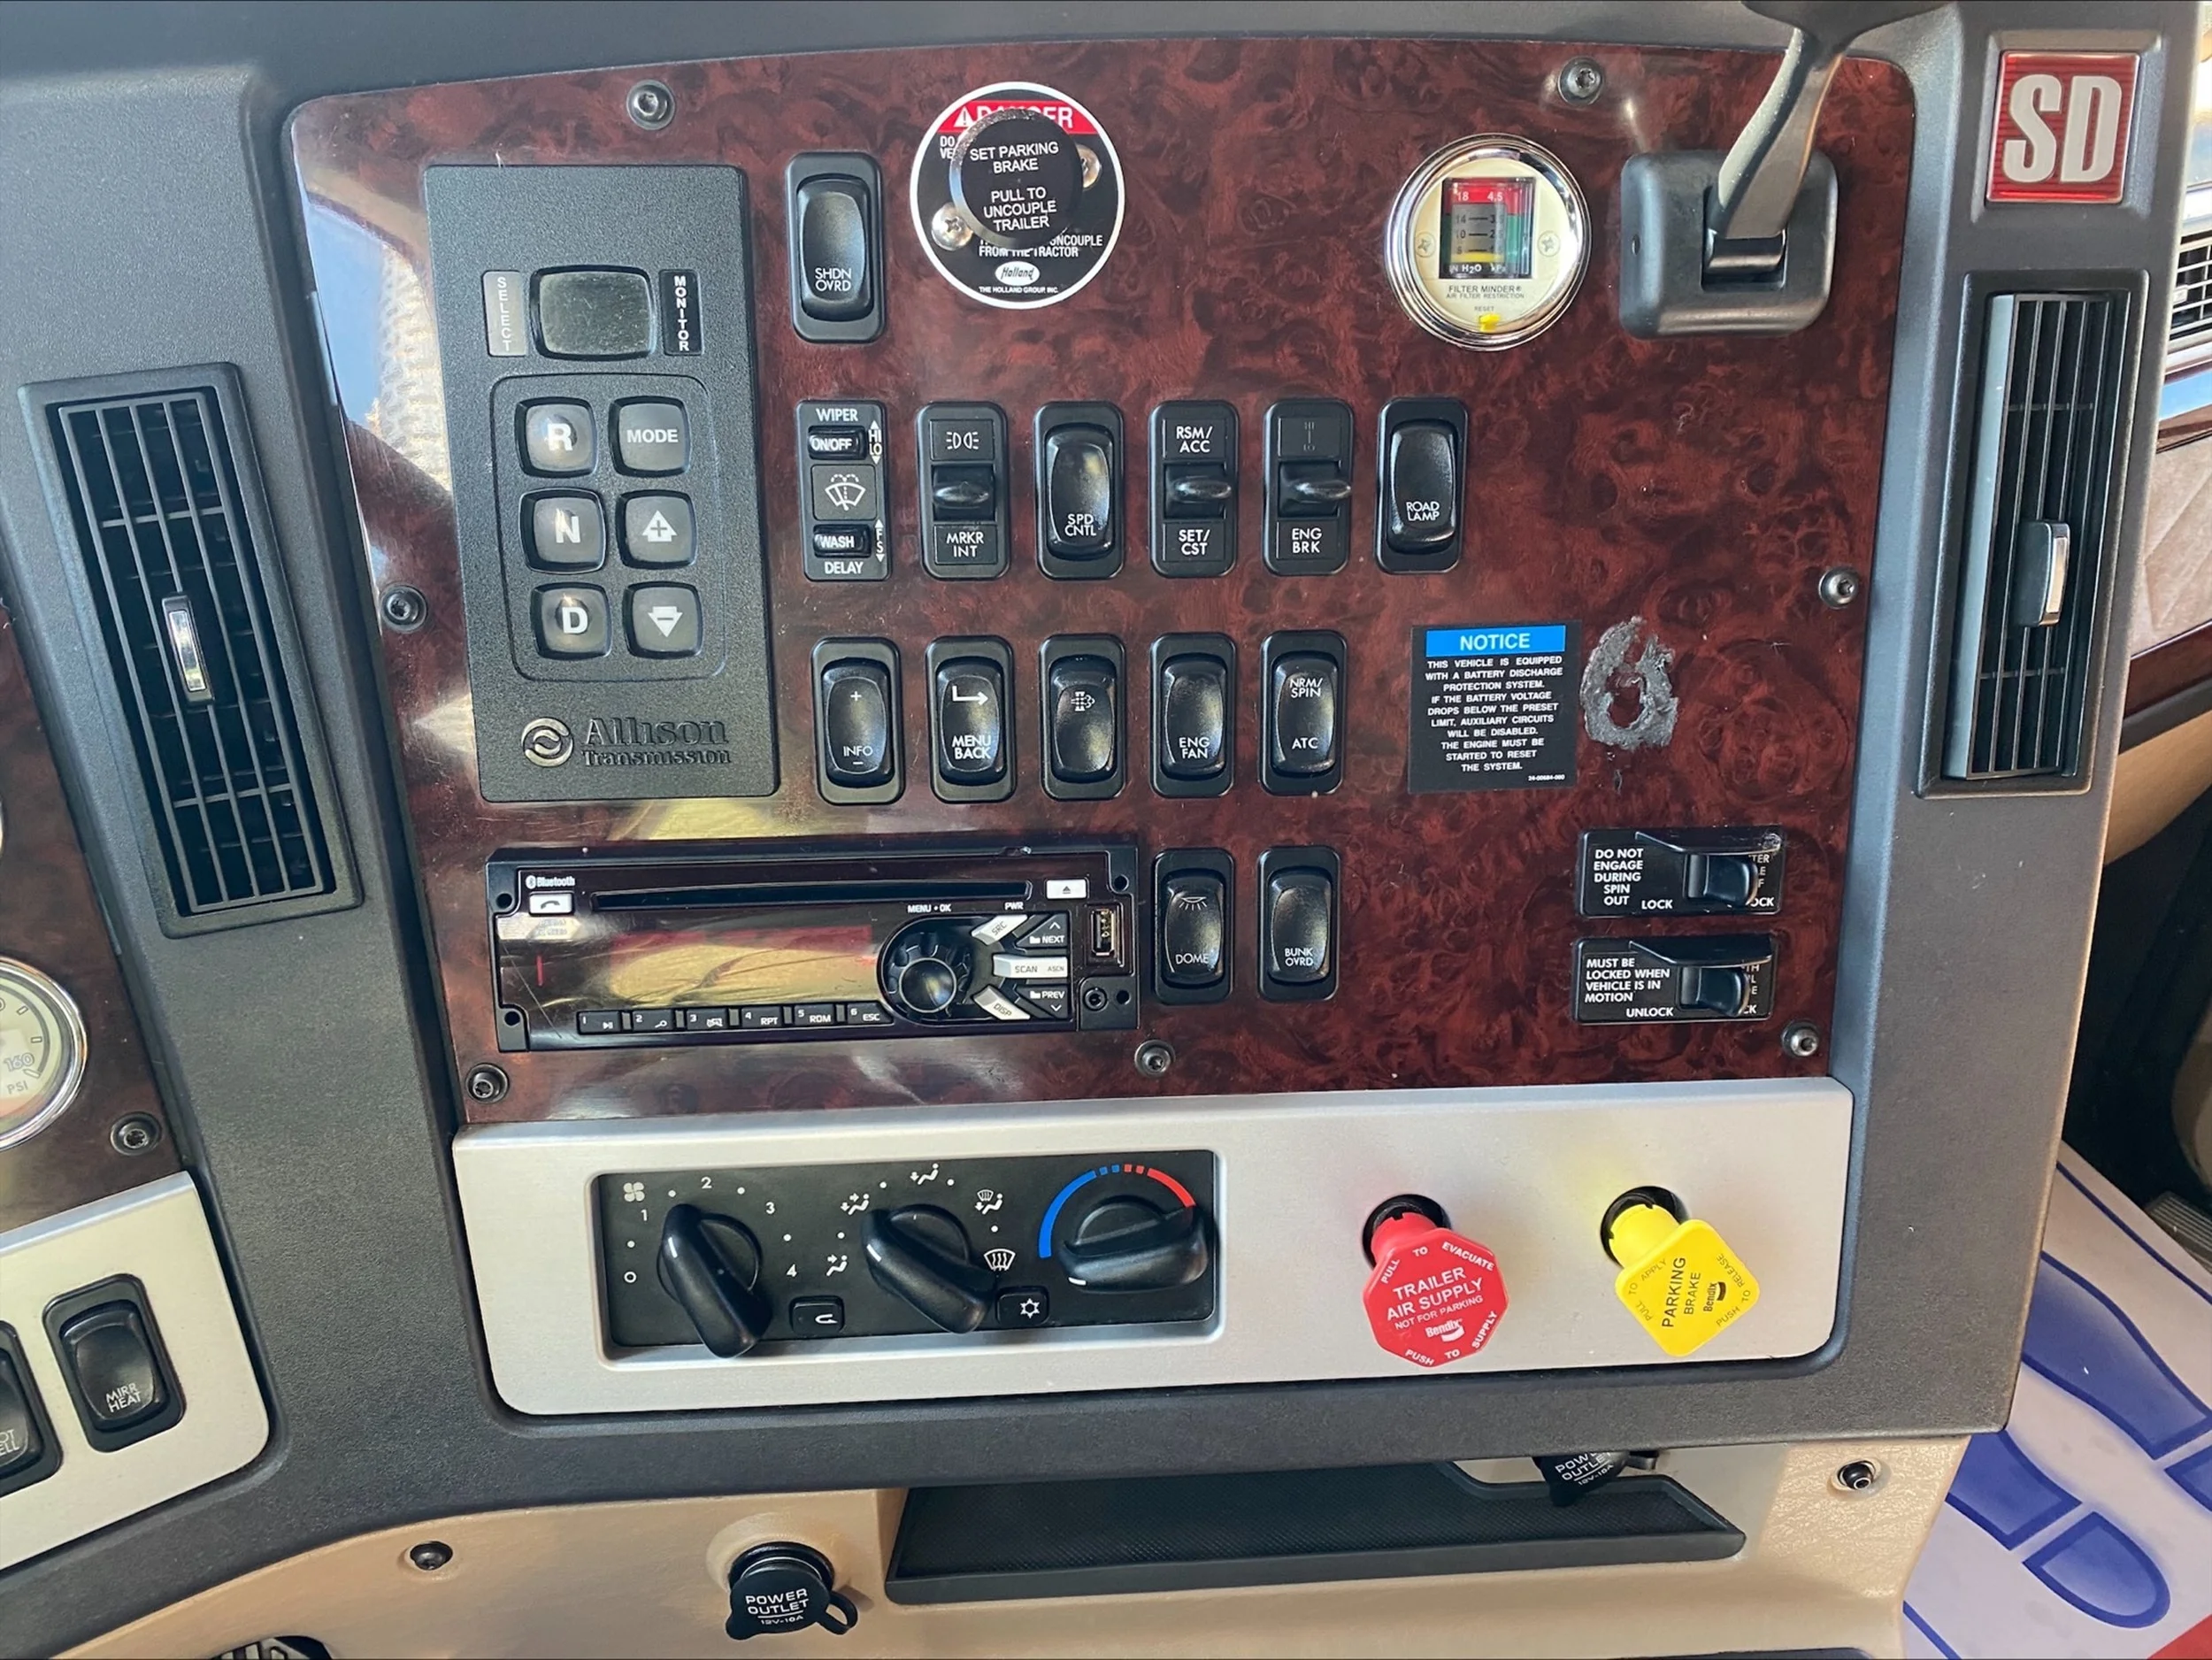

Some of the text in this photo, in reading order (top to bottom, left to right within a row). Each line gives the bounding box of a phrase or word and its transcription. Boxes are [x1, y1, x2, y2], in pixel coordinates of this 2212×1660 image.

[2002, 74, 2122, 183] SD
[941, 136, 955, 147] DO
[970, 147, 995, 161] SET
[999, 142, 1059, 158] PARKING
[994, 158, 1039, 173] BRAKE
[991, 187, 1046, 203] PULL TO
[1458, 191, 1502, 202] 18 4.5
[984, 200, 1056, 219] UNCOUPLE
[994, 216, 1049, 232] TRAILER
[979, 246, 1008, 257] FROM
[815, 267, 851, 280] SHDN
[1001, 267, 1034, 280] Holland
[815, 280, 851, 291] OVRD
[497, 277, 511, 350] SELECT
[674, 276, 689, 351] MONITOR
[816, 409, 858, 422] WIPER
[547, 423, 573, 451] R
[626, 429, 679, 442] MODE
[868, 429, 881, 442] HI
[1176, 426, 1212, 440] RSM/
[810, 437, 852, 450] ON/OFF
[869, 442, 882, 455] LO
[1179, 441, 1210, 453] ACC
[1406, 502, 1440, 511] ROAD
[1067, 514, 1094, 526] SPD
[1407, 511, 1440, 521] LAMP
[556, 513, 580, 543] N
[1065, 525, 1096, 536] CNTL
[1292, 527, 1322, 540] ENG
[819, 535, 855, 548] WASH
[946, 532, 984, 544] MRKR
[1179, 529, 1210, 542] SET/
[877, 542, 884, 554] S
[953, 545, 977, 557] INT
[1180, 542, 1208, 555] CST
[1292, 541, 1320, 554] BRK
[825, 562, 864, 574] DELAY
[562, 607, 588, 634] D
[1460, 633, 1530, 650] NOTICE
[1455, 658, 1494, 668] VEHICLE
[1517, 656, 1562, 665] EQUIPPED
[1464, 670, 1505, 679] BATTERY
[1509, 667, 1563, 677] DISCHARGE
[1290, 678, 1323, 688] NRM/
[1443, 680, 1545, 692] PROTECTION SYSTEM.
[1291, 688, 1321, 698] SPIN
[1466, 694, 1507, 703] BATTERY
[1511, 691, 1552, 701] VOLTAGE
[1428, 707, 1459, 716] DROPS
[1463, 705, 1497, 714] BELOW
[1523, 703, 1559, 711] PRESET
[1461, 717, 1508, 726] AUXILIARY
[585, 717, 729, 745] Allison
[1491, 726, 1538, 736] DISABLED.
[952, 735, 991, 747] MENU
[1179, 737, 1210, 748] ENG
[1292, 738, 1318, 749] ATC
[1463, 740, 1497, 749] ENGINE
[581, 749, 731, 766] Transmission
[843, 746, 872, 757] INFO
[955, 748, 991, 759] BACK
[1182, 748, 1208, 759] FAN
[1446, 752, 1487, 761] STARTED
[1507, 749, 1537, 758] RESET
[1484, 762, 1523, 771] SYSTEM.
[1595, 849, 1644, 859] DO NOT
[1594, 860, 1643, 871] ENGAGE
[1594, 872, 1641, 883] DURING
[1603, 884, 1630, 894] SPIN
[1603, 895, 1630, 905] OUT
[1641, 900, 1672, 910] LOCK
[908, 903, 951, 913] MENU OK
[991, 921, 1007, 935] SRC
[1175, 953, 1209, 964] DOME
[1285, 948, 1313, 957] BUNK
[1285, 957, 1314, 966] OVRD
[1586, 958, 1635, 968] MUST BE
[1586, 968, 1670, 980] LOCKED WHEN
[1586, 980, 1661, 991] VEHICLE IS IN
[1585, 993, 1633, 1003] MOTION
[993, 1003, 1012, 1016] DISP
[1625, 1007, 1674, 1018] UNLOCK
[6, 1053, 35, 1072] 160
[7, 1080, 28, 1095] PSI
[701, 1177, 712, 1189] 2
[765, 1203, 775, 1214] 3
[641, 1209, 648, 1221] 1
[1381, 1241, 1494, 1284] PULL TO EVACUATE
[786, 1264, 797, 1278] 4
[1393, 1267, 1466, 1301] TRAILER
[1628, 1258, 1667, 1321] PULL TO APPLY
[1662, 1257, 1686, 1327] PARKING
[1684, 1272, 1701, 1315] BRAKE
[1716, 1254, 1751, 1327] PUSH TO RELEASE
[1387, 1278, 1483, 1321] AIR SUPPLY
[1394, 1295, 1483, 1330] NOT FOR PARKING
[1405, 1310, 1497, 1366] PUSH TO SUPPLY
[106, 1383, 138, 1404] MIRR
[108, 1392, 142, 1413] HEAT
[745, 1588, 808, 1604] POWER
[748, 1599, 809, 1615] OUTLET
